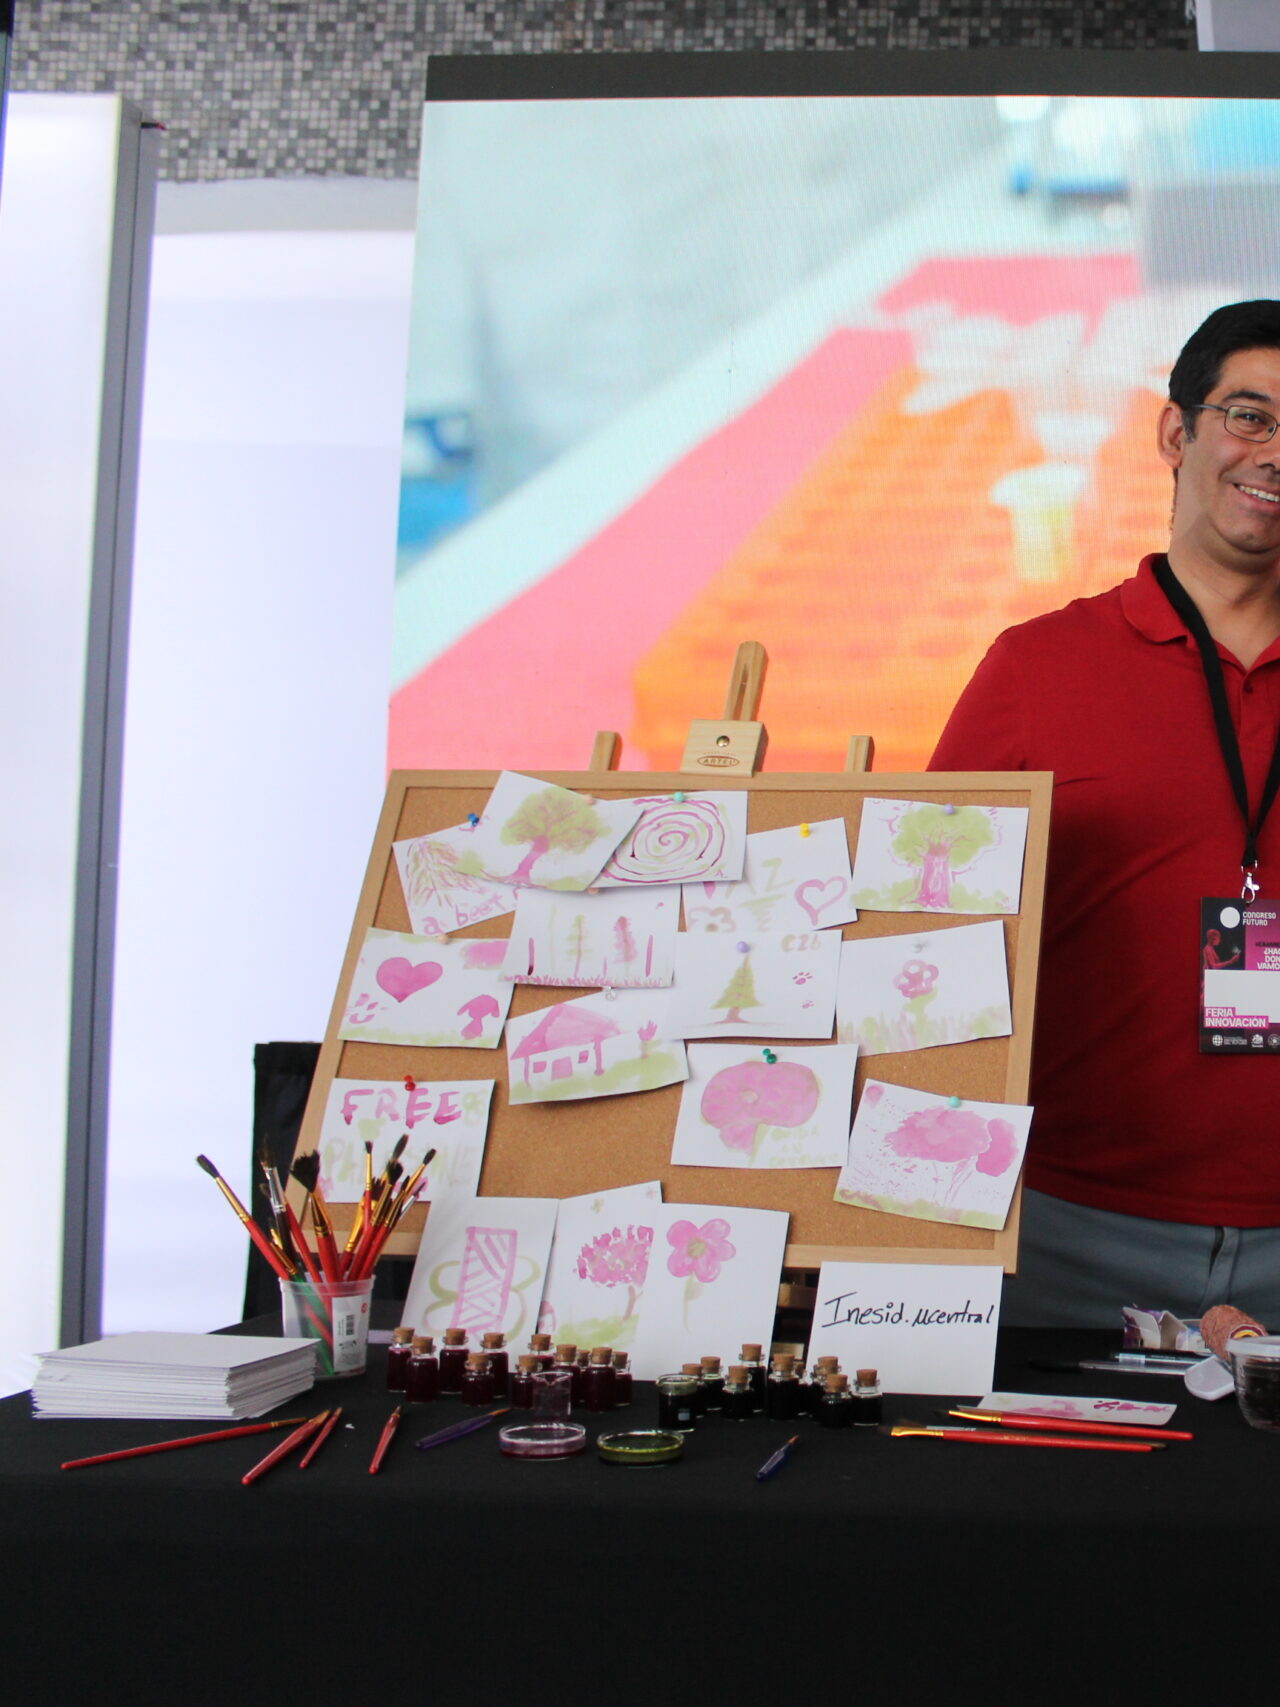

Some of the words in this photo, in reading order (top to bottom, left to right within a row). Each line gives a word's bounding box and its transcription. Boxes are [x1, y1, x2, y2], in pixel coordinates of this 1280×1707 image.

[1242, 911, 1277, 919] CONGRESO
[1205, 1007, 1234, 1017] FERIA
[341, 1087, 462, 1129] FREE
